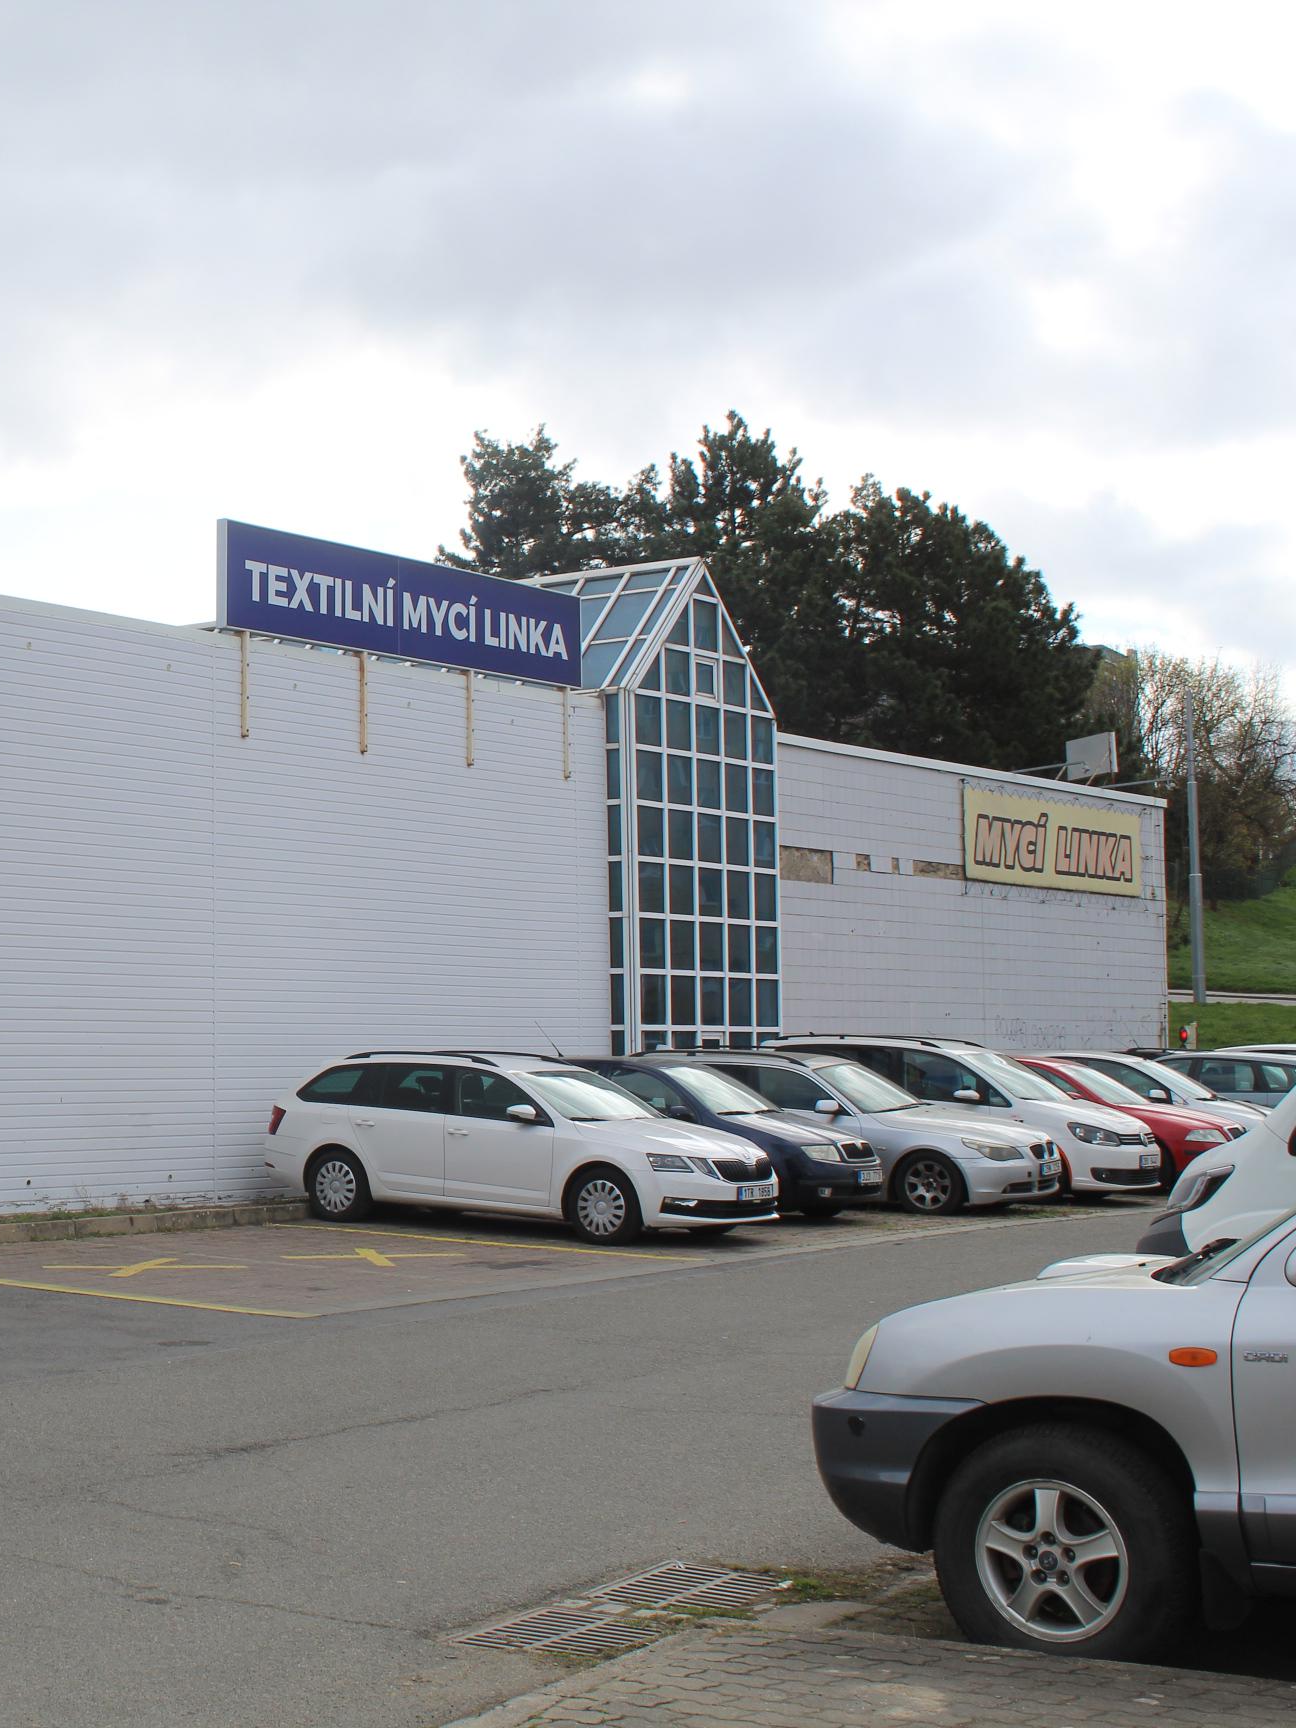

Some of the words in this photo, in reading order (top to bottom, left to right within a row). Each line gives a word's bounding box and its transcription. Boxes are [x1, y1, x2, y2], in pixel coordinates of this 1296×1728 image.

[245, 559, 396, 628] TEXTILNÍ
[402, 592, 478, 643] MYCÍ
[484, 608, 569, 661] LINKA
[974, 813, 1048, 873] MYCÍ
[1055, 825, 1133, 882] LINKA
